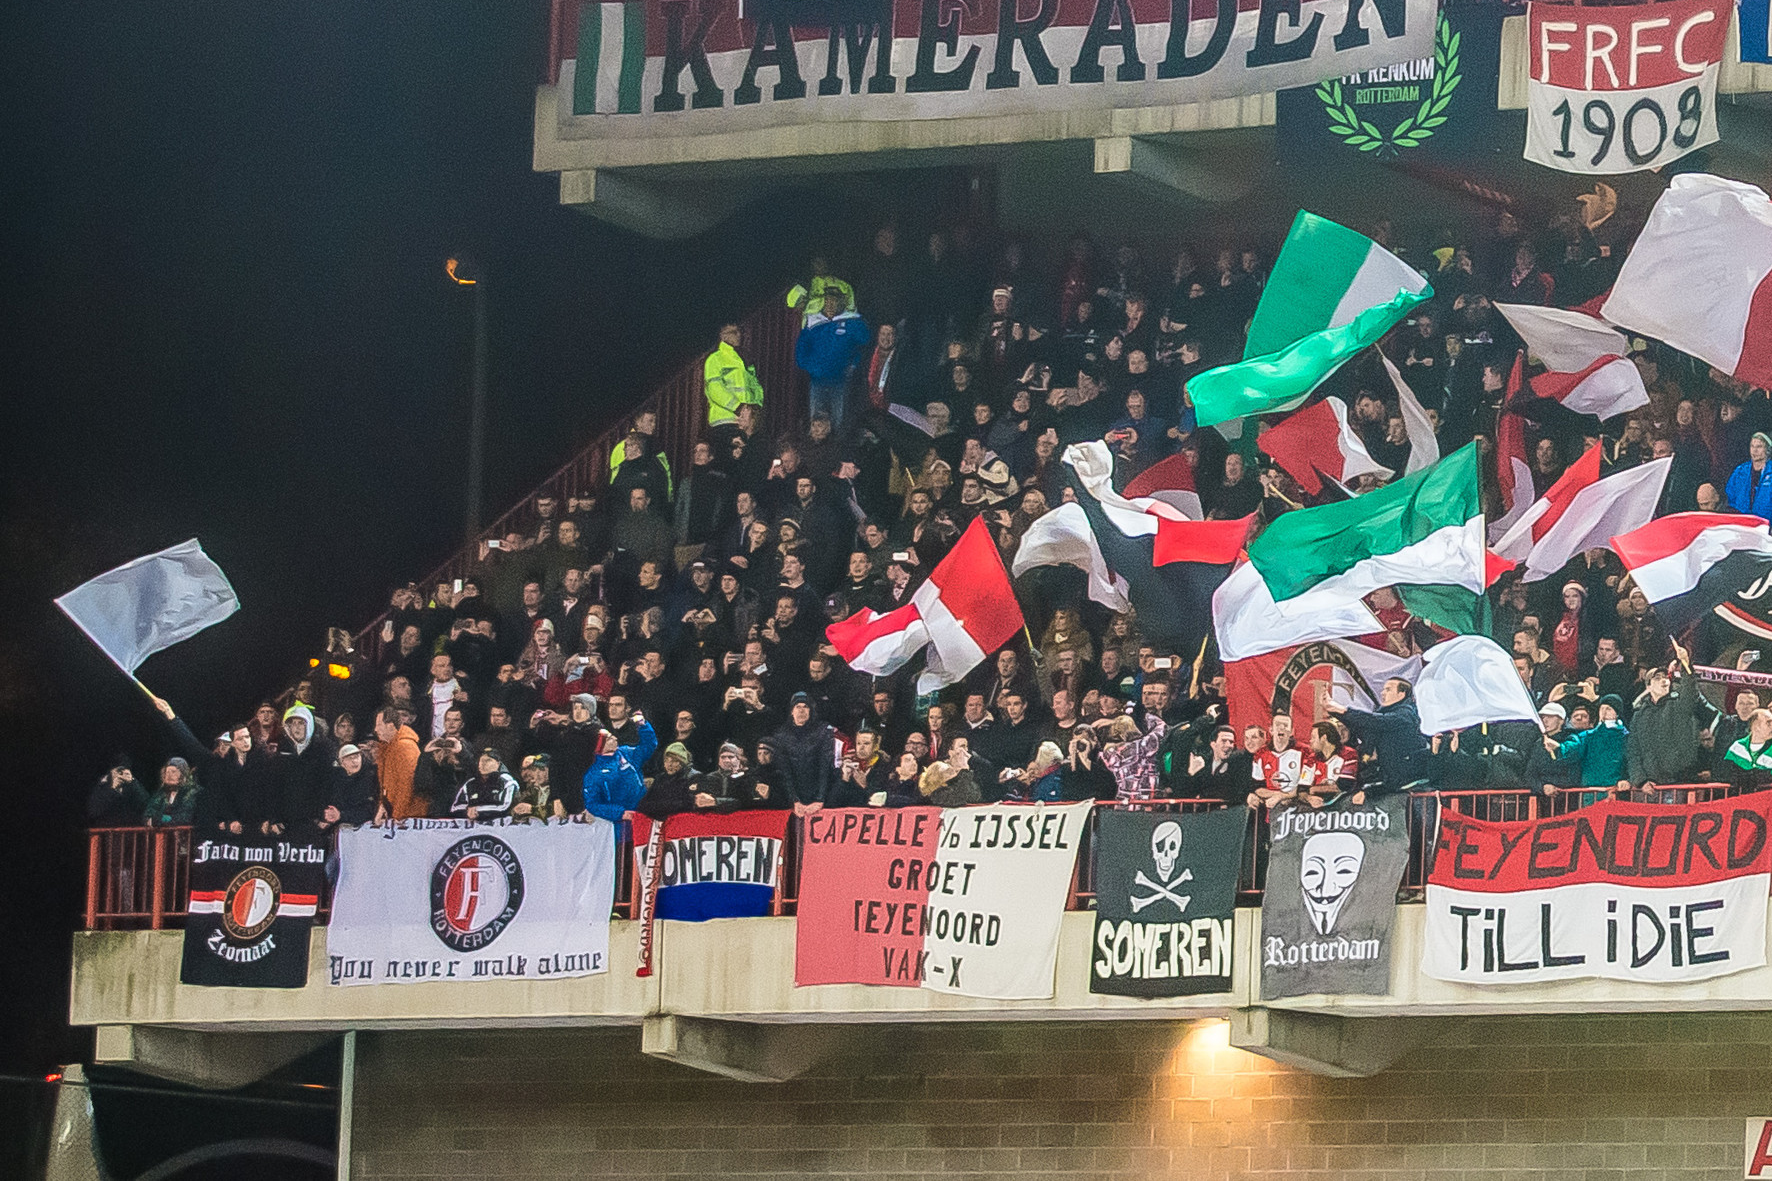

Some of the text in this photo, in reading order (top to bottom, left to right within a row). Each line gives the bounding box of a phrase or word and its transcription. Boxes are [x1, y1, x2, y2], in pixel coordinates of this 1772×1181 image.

[1540, 10, 1716, 91] FRFC
[1355, 85, 1420, 105] ROTTERDAM
[1552, 84, 1702, 167] 1908
[808, 812, 928, 848] CAPELLE
[969, 812, 1070, 850] IJSSEL
[1274, 806, 1391, 841] Feyenoord
[243, 846, 273, 863] non
[277, 841, 325, 864] Verba
[438, 839, 518, 878] FEYENOORD
[642, 835, 775, 887] OMEREN
[1433, 808, 1767, 880] FEYENOORD
[886, 858, 977, 896] GROET
[433, 907, 517, 949] ROTTERDAM
[1095, 917, 1232, 979] SOMEREN
[1264, 936, 1381, 968] Rotterdam
[330, 951, 602, 987] You never walk alone
